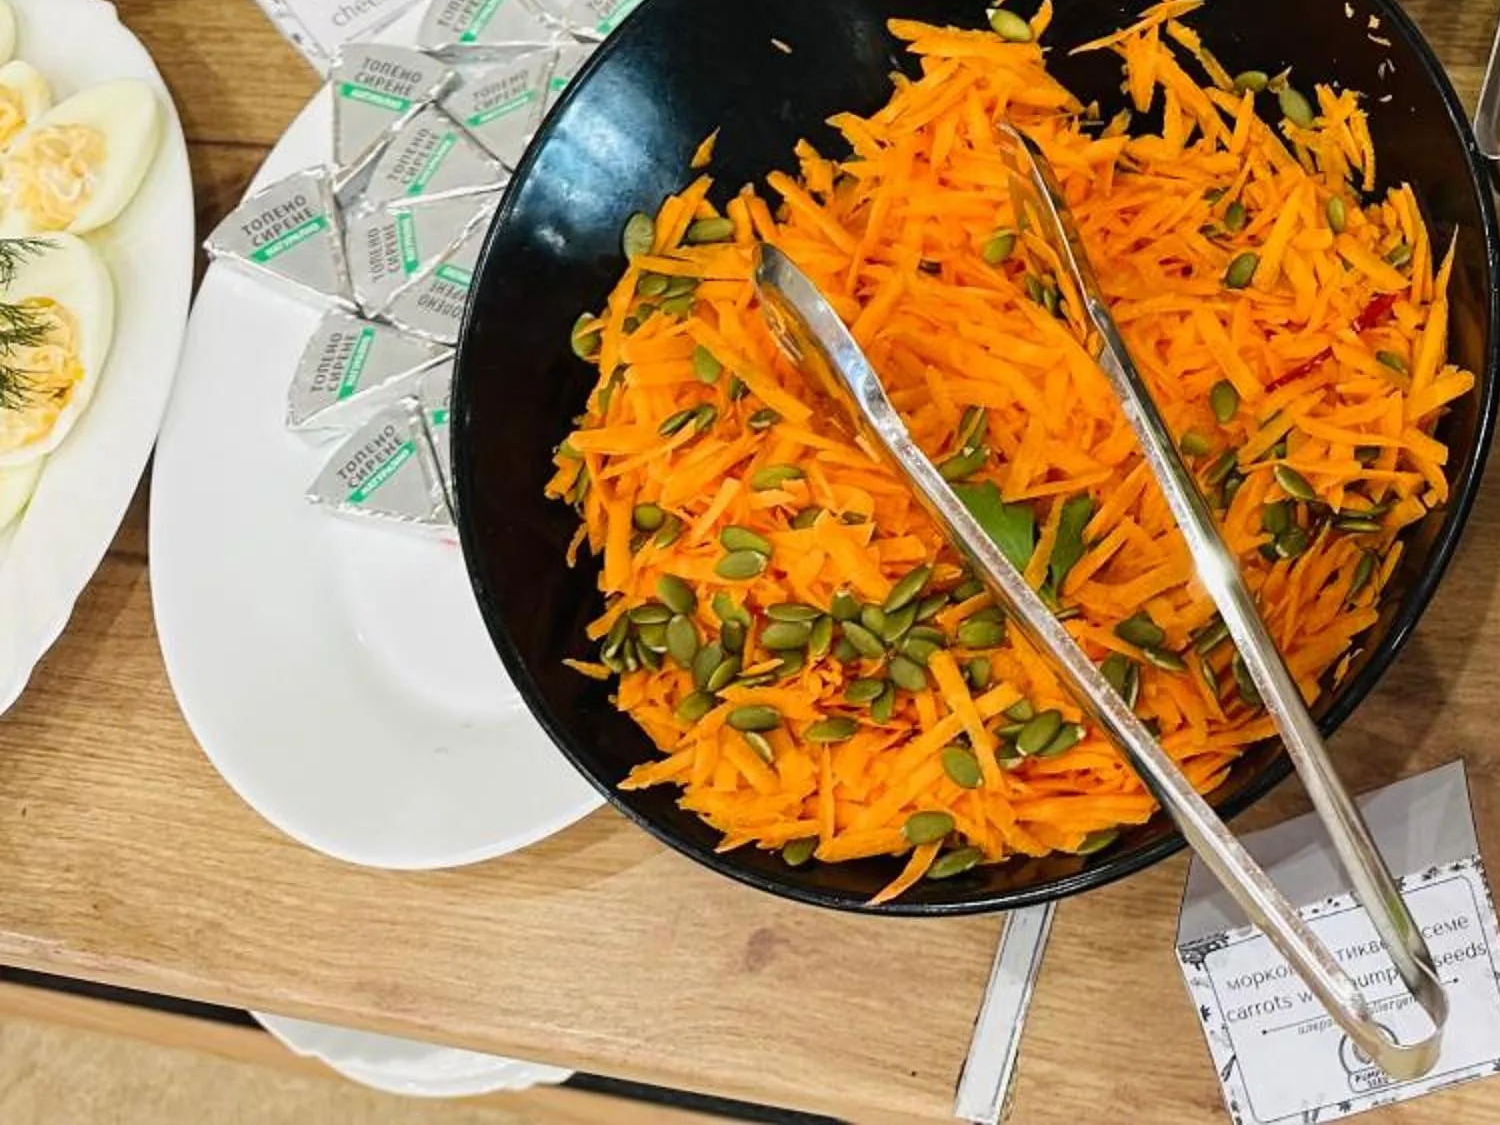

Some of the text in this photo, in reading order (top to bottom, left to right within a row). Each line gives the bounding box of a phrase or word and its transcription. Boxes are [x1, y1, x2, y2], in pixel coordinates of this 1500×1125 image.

[363, 56, 423, 84] ТОПЕНО
[242, 195, 307, 235] ТОПЕНО
[253, 208, 313, 247] СИРЕНЕ
[311, 332, 342, 392] ТОПЕНО
[336, 425, 395, 479] ТОПЕНО
[348, 435, 402, 488] СИРЕНЕ
[1334, 939, 1389, 962] тикве
[1421, 915, 1469, 940] семе
[1226, 995, 1293, 1022] carrots
[1433, 941, 1487, 968] seeds
